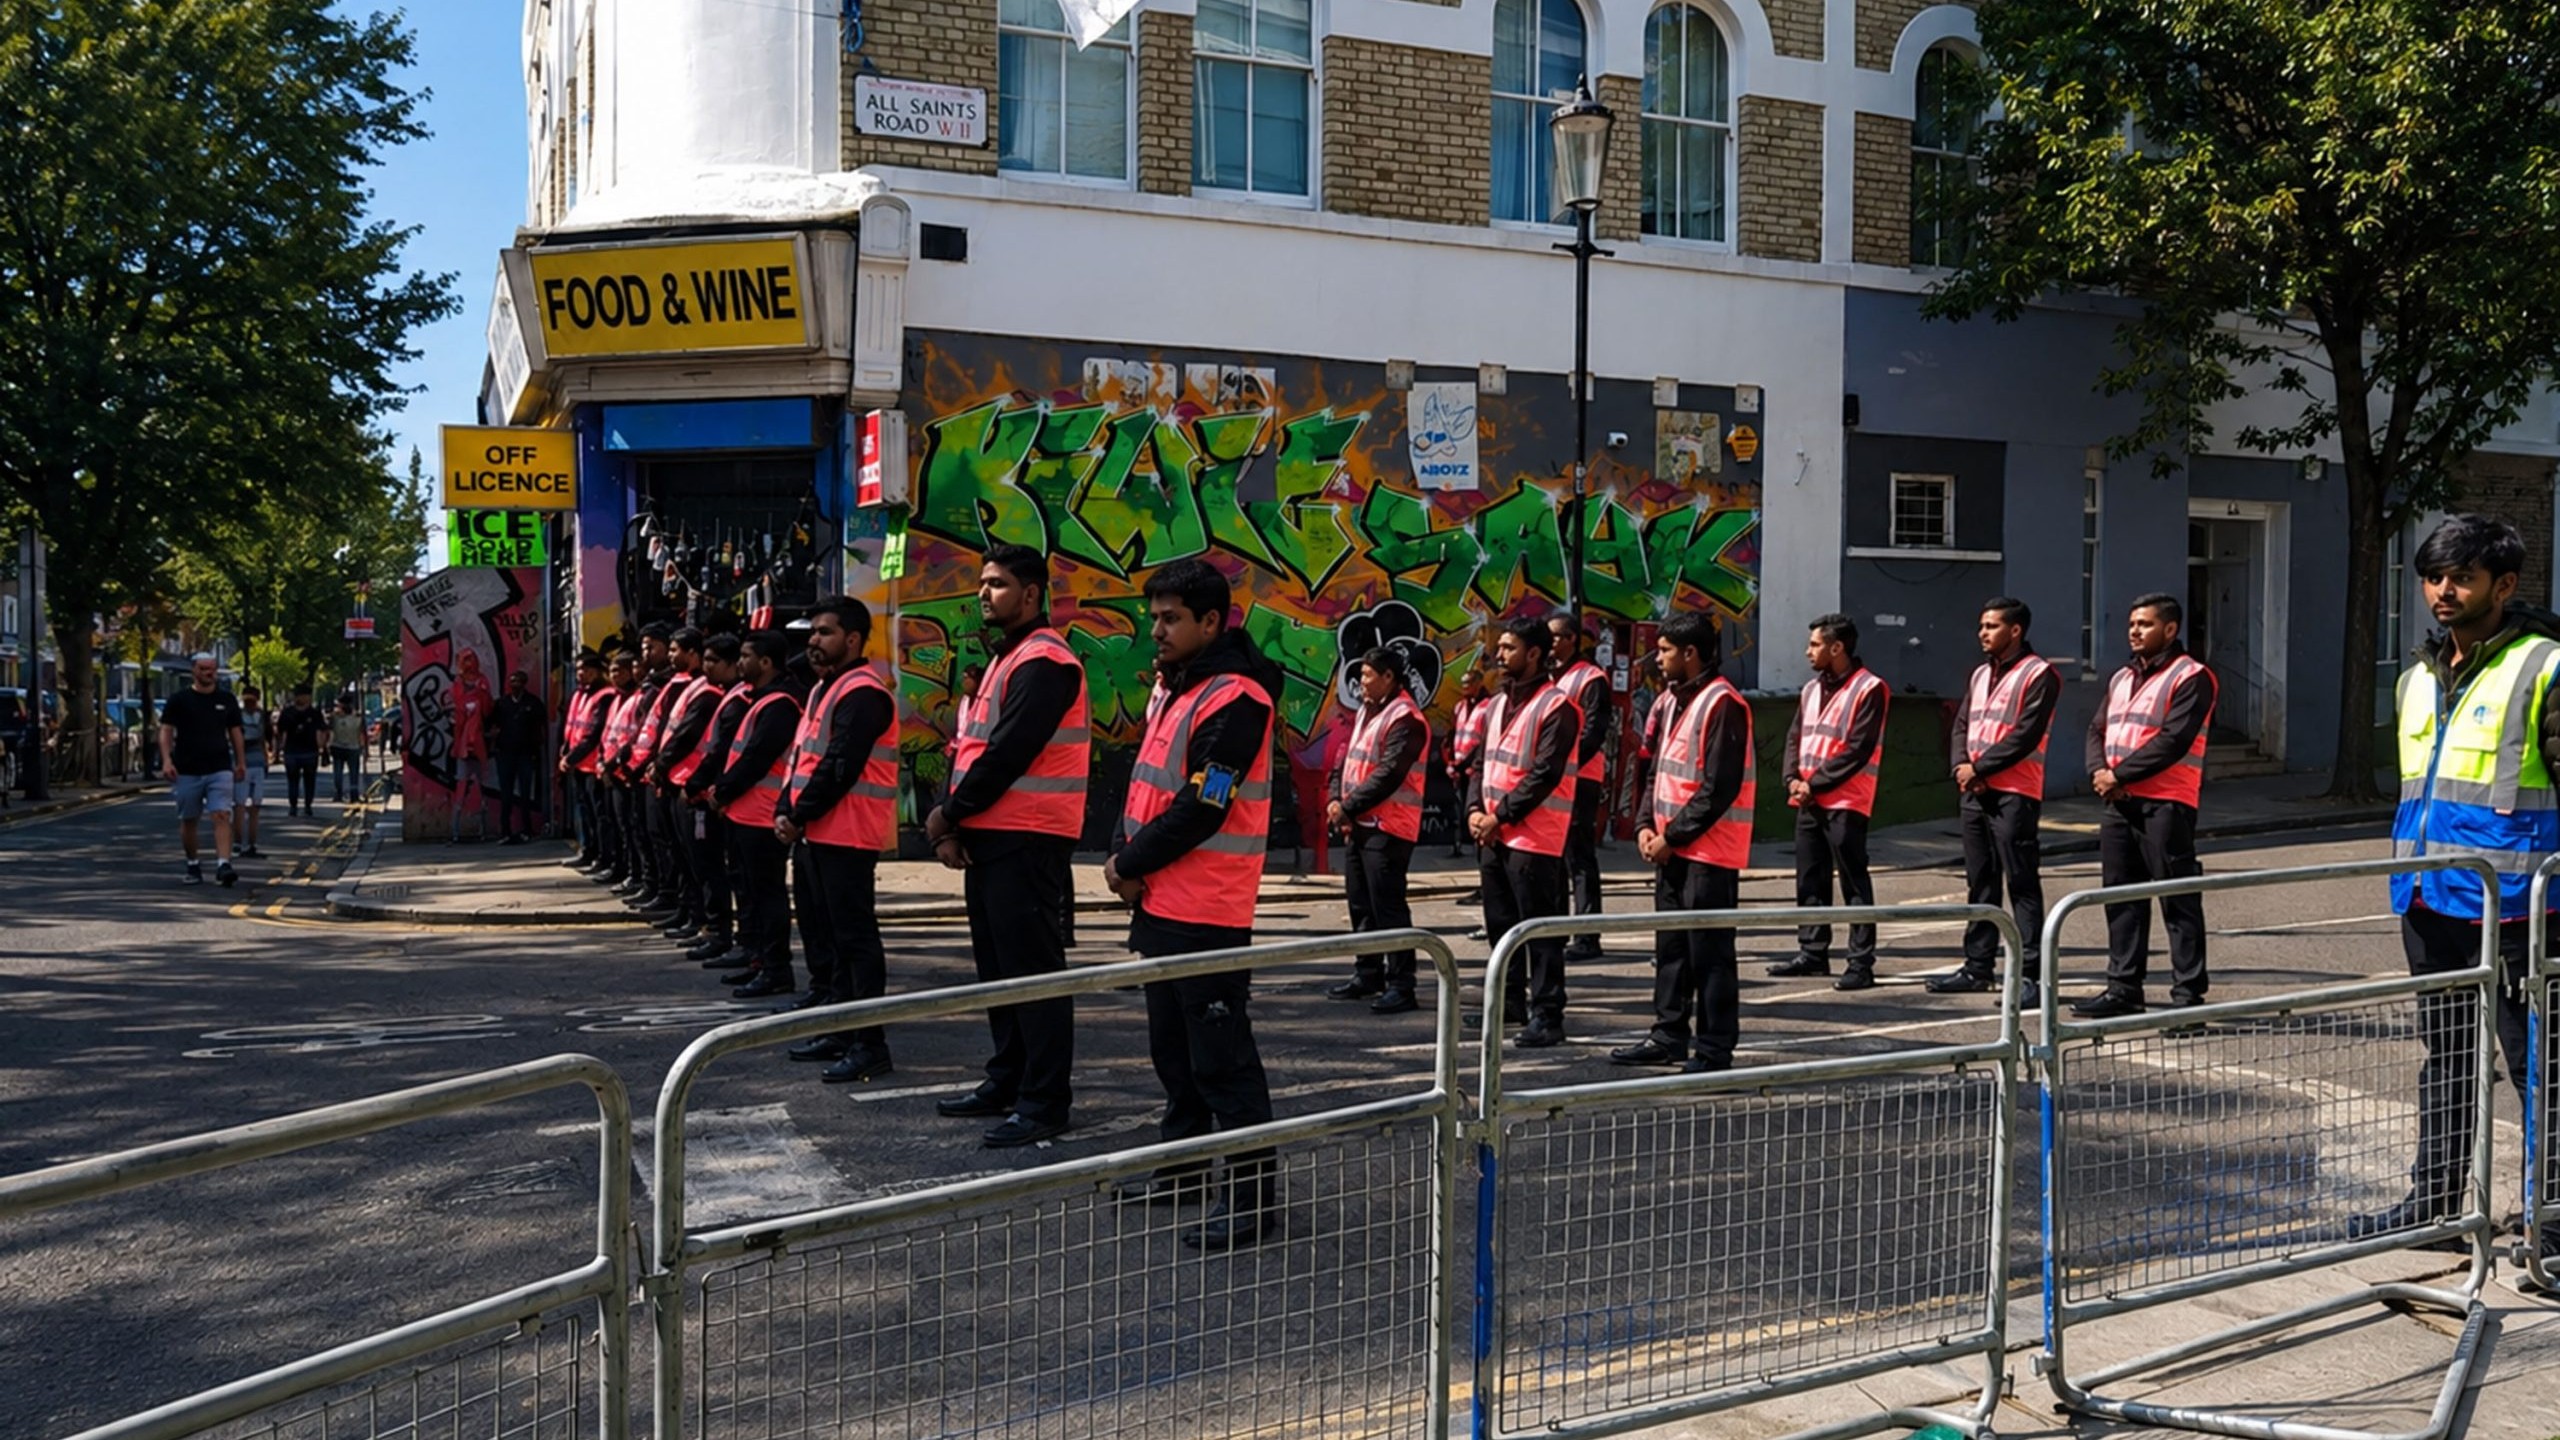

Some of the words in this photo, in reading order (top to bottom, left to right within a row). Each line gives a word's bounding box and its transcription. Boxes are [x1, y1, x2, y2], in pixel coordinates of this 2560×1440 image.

[866, 94, 899, 112] ALL
[910, 98, 977, 120] SAINTS
[874, 113, 930, 134] ROAD
[543, 274, 651, 331] FOOD
[661, 272, 691, 326] &
[689, 265, 797, 323] WINE
[485, 445, 538, 465] OFF
[454, 471, 570, 493] LICENCE
[456, 509, 537, 539] ICE
